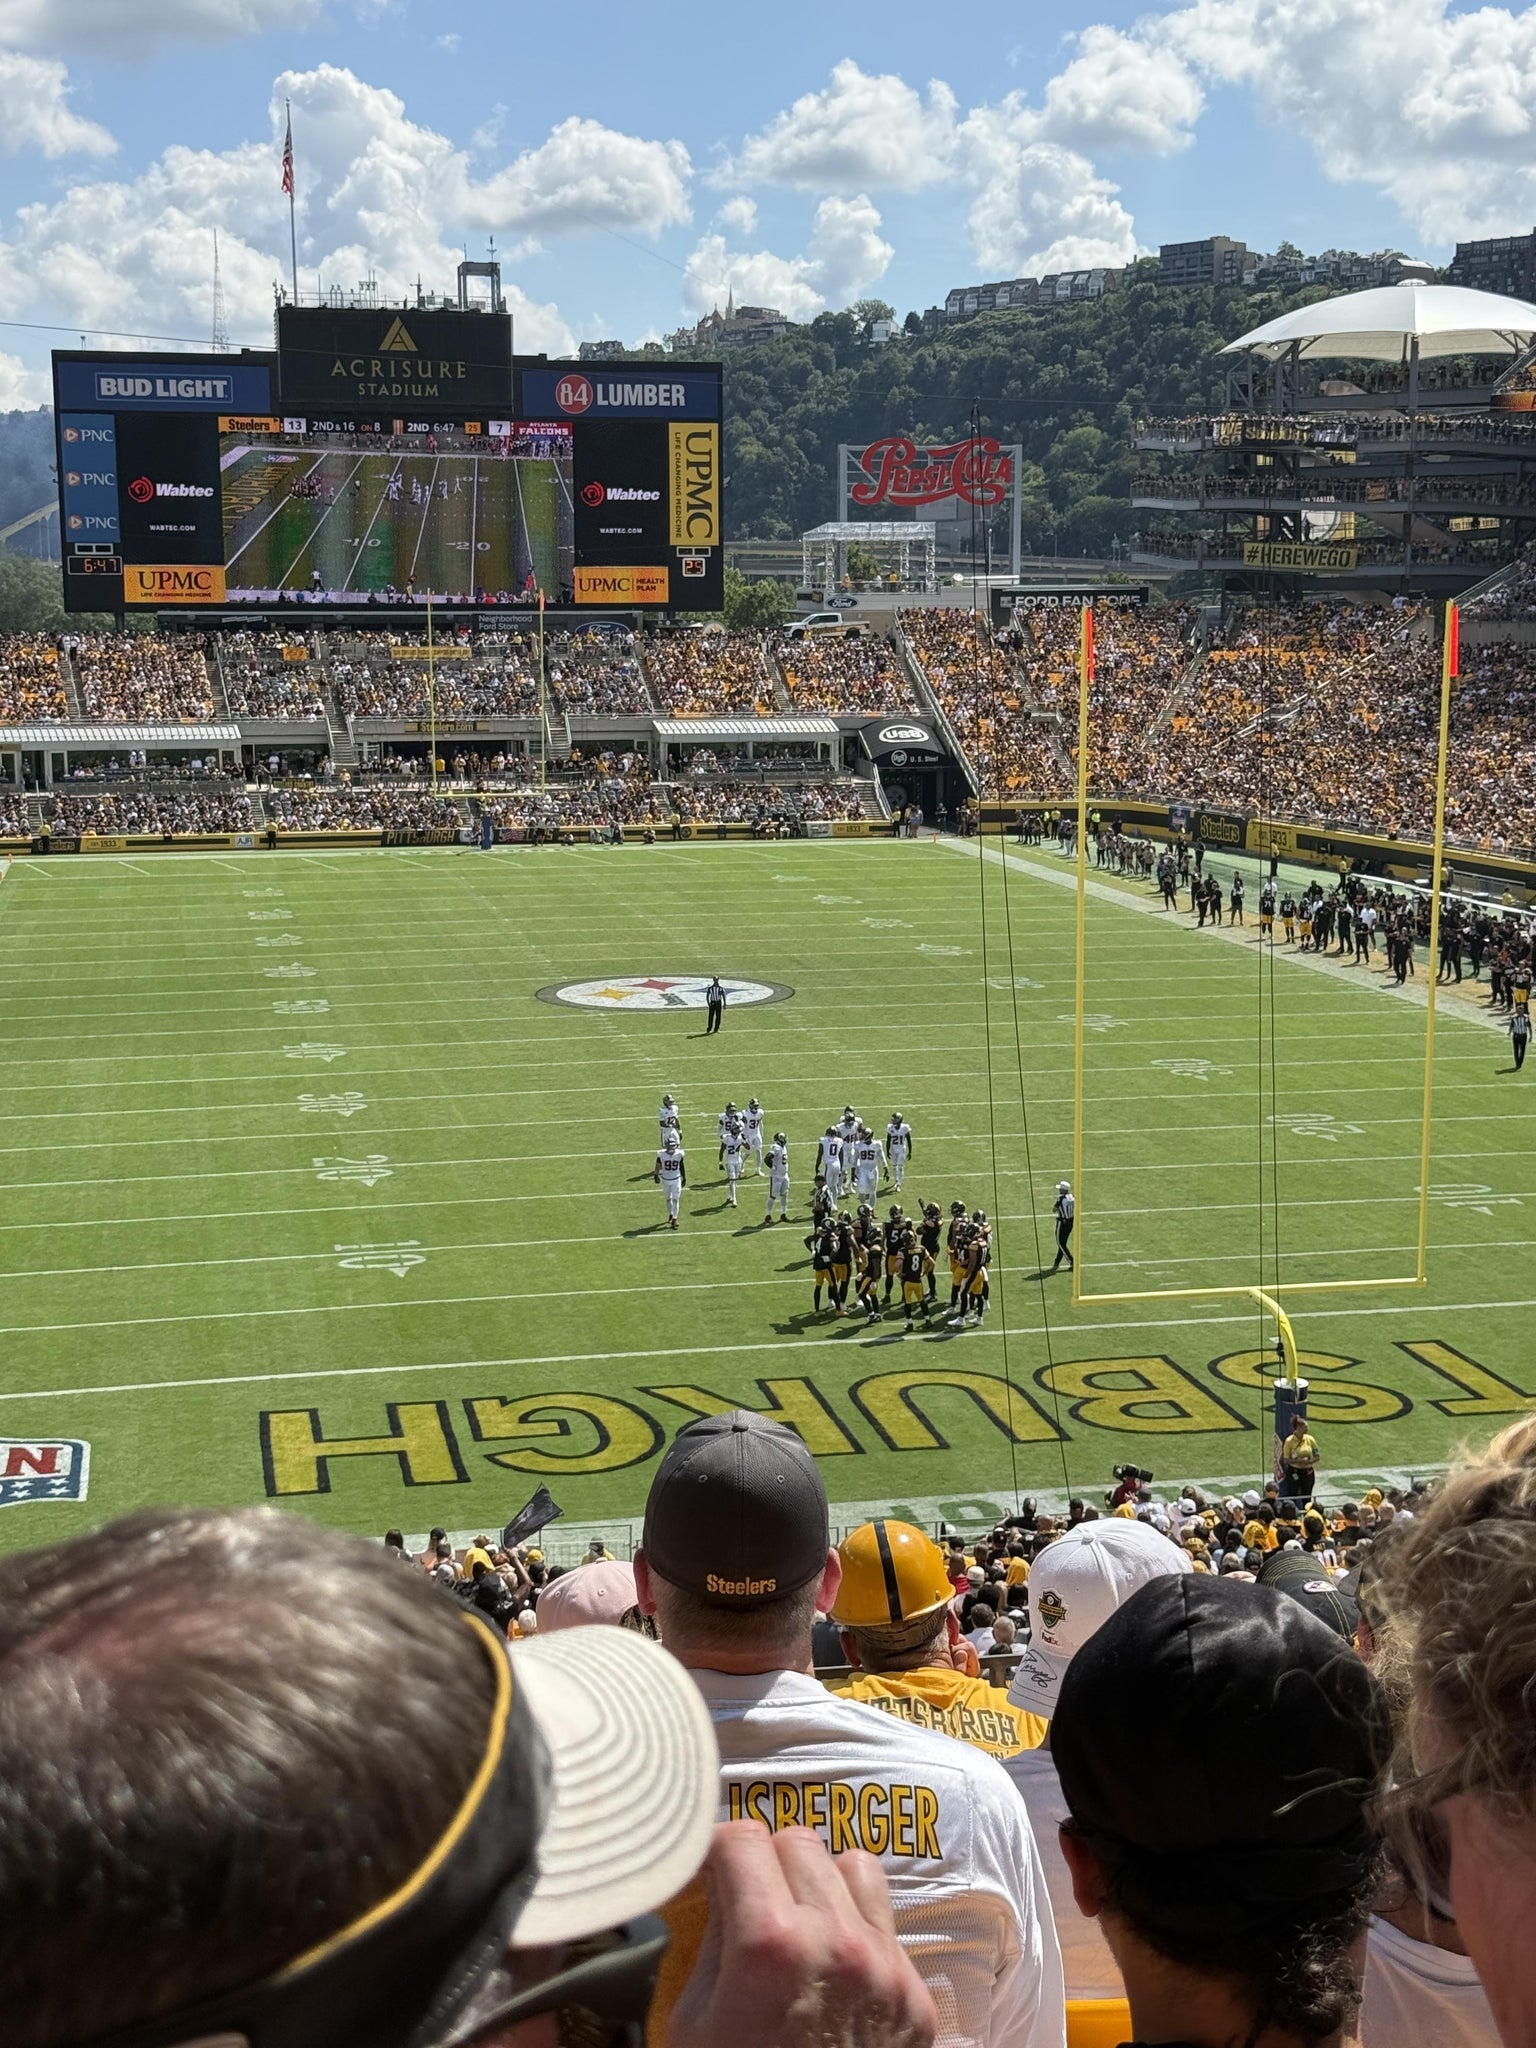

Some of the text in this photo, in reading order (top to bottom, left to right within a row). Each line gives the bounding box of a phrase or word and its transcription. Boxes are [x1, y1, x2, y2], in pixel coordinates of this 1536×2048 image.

[331, 359, 467, 379] ACRISURE
[100, 378, 228, 398] BUD LIGHT
[358, 383, 440, 397] STADIUM
[559, 384, 686, 407] 84 LUMBER
[229, 419, 270, 431] Steelers
[289, 421, 302, 431] 13
[312, 421, 334, 431] 2ND
[343, 421, 355, 431] 16
[374, 421, 381, 432] 8
[408, 422, 455, 432] 2ND 6:47
[81, 429, 113, 442] PNC
[83, 473, 115, 486] PNC
[686, 429, 713, 539] UPMC
[156, 484, 214, 497] Wabtec
[606, 488, 660, 501] Wabtec
[85, 516, 117, 530] PNC
[675, 498, 683, 538] MEDICINE
[149, 524, 196, 532] WABTEC.COM
[600, 527, 642, 535] WABTEC.COM
[1246, 545, 1351, 568] #HEREWEGO
[84, 558, 117, 573] 6:47
[138, 571, 212, 590] UPMC
[579, 578, 631, 592] UPMC
[1015, 596, 1058, 607] FORD
[1062, 596, 1094, 607] FAN
[478, 615, 533, 624] Neighborhood
[1200, 815, 1240, 842] Steelers
[387, 831, 455, 845] PITTSURGH
[663, 1160, 680, 1171] 99
[911, 1254, 920, 1272] 8
[706, 1573, 777, 1596] Steelers
[1041, 1631, 1058, 1646] FedEx
